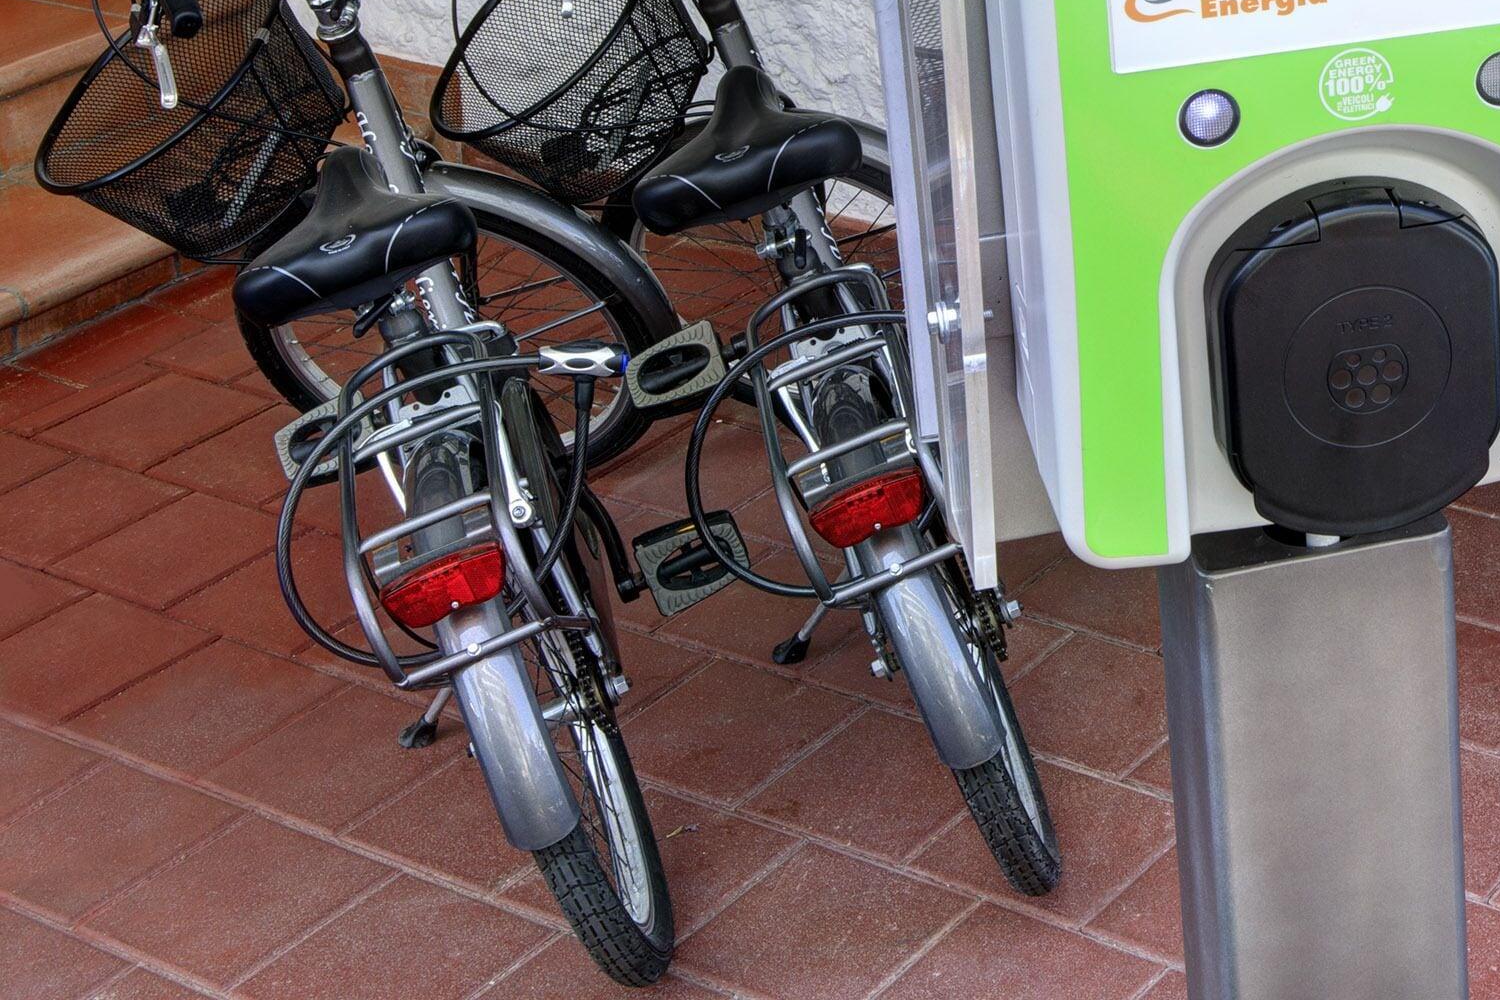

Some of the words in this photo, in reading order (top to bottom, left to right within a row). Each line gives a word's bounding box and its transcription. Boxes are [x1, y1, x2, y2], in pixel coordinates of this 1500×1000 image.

[1335, 55, 1376, 68] GREEN
[1328, 63, 1382, 79] ENERGY
[1324, 72, 1386, 96] 100%
